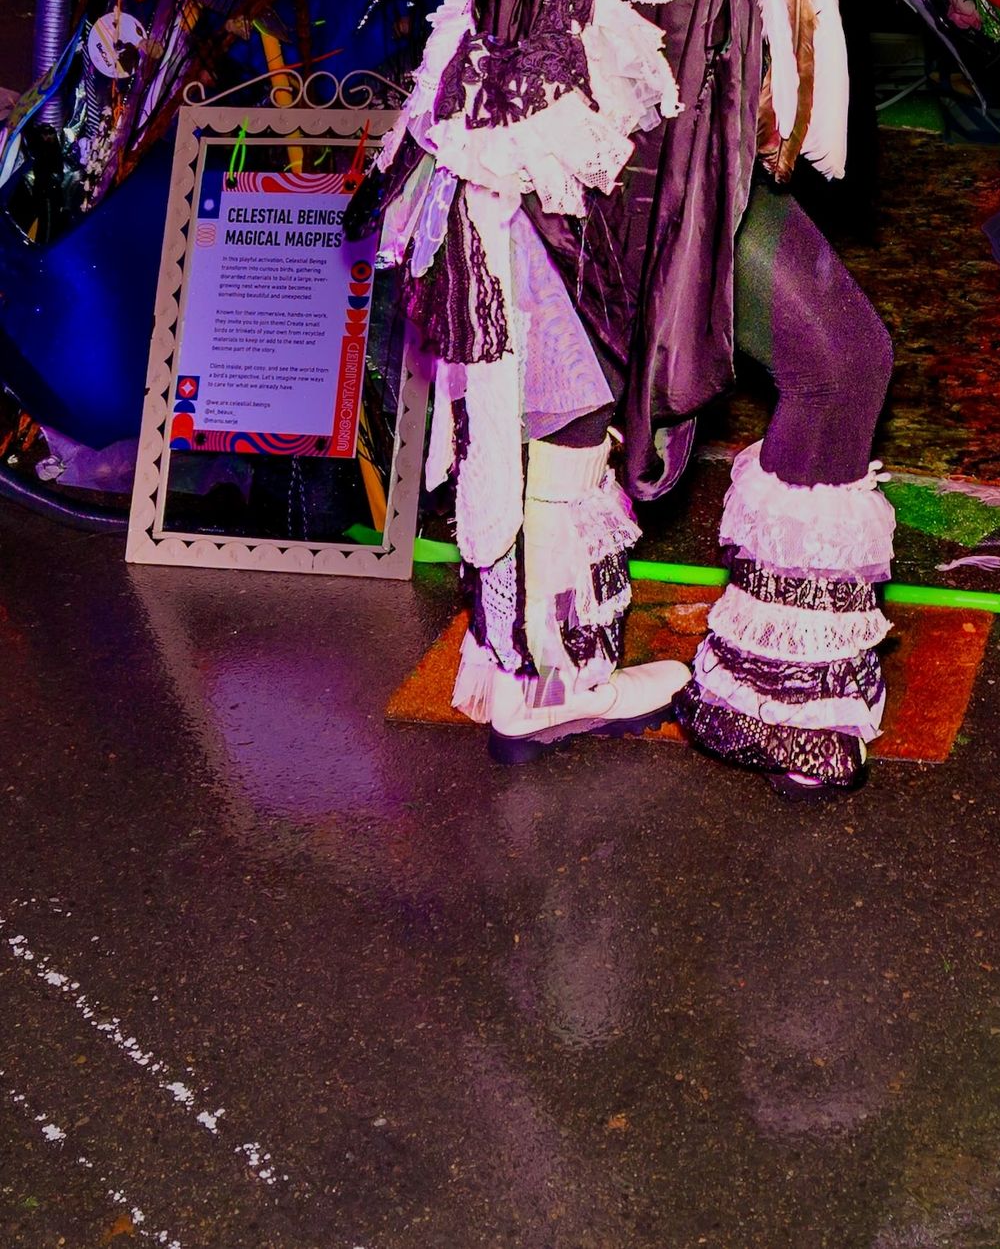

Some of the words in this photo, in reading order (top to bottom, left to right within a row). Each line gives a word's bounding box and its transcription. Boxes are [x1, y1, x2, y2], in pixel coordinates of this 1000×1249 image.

[228, 208, 293, 224] CELESTIAL
[297, 209, 344, 226] BEINGS
[224, 230, 280, 246] MAGICAL
[284, 231, 342, 248] MAGPIES
[336, 342, 360, 452] UNCONTAINED
